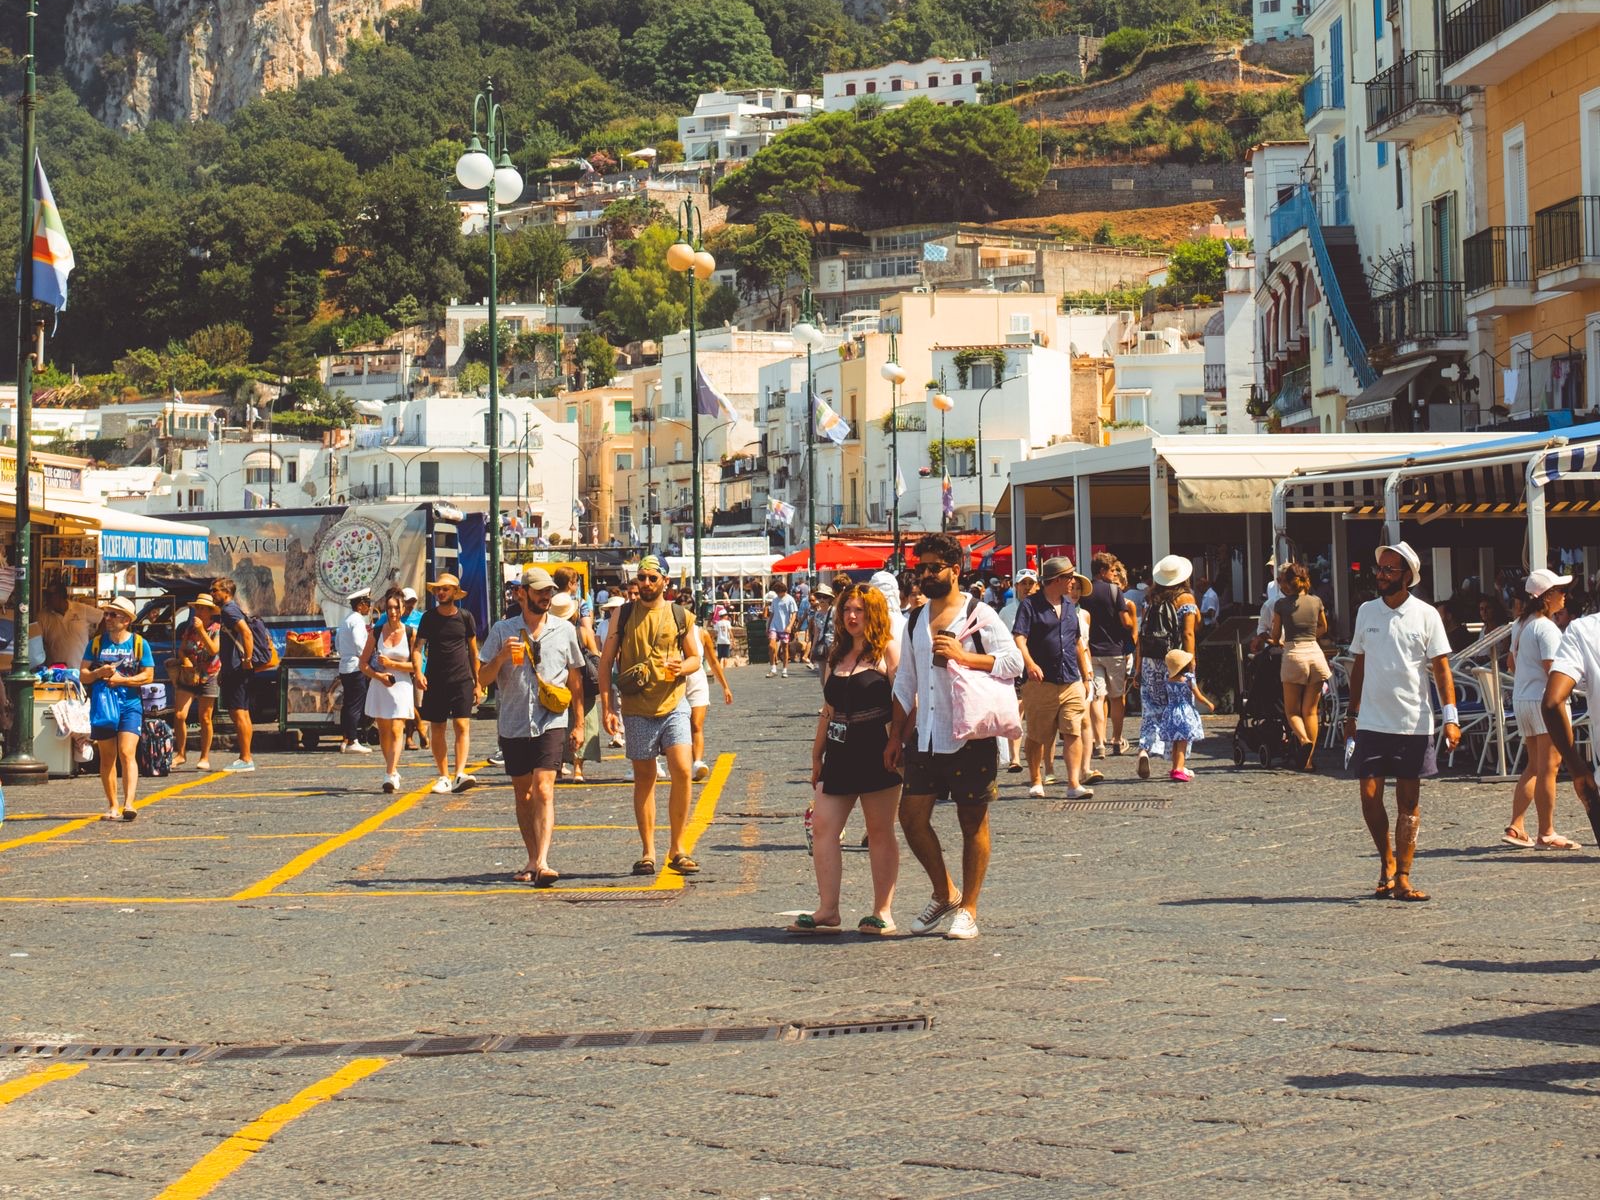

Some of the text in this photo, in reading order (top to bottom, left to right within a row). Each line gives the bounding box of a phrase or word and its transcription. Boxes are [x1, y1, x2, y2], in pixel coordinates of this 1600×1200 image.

[1, 457, 17, 471] TICKE
[103, 535, 121, 557] TICKET
[121, 536, 138, 558] POINT
